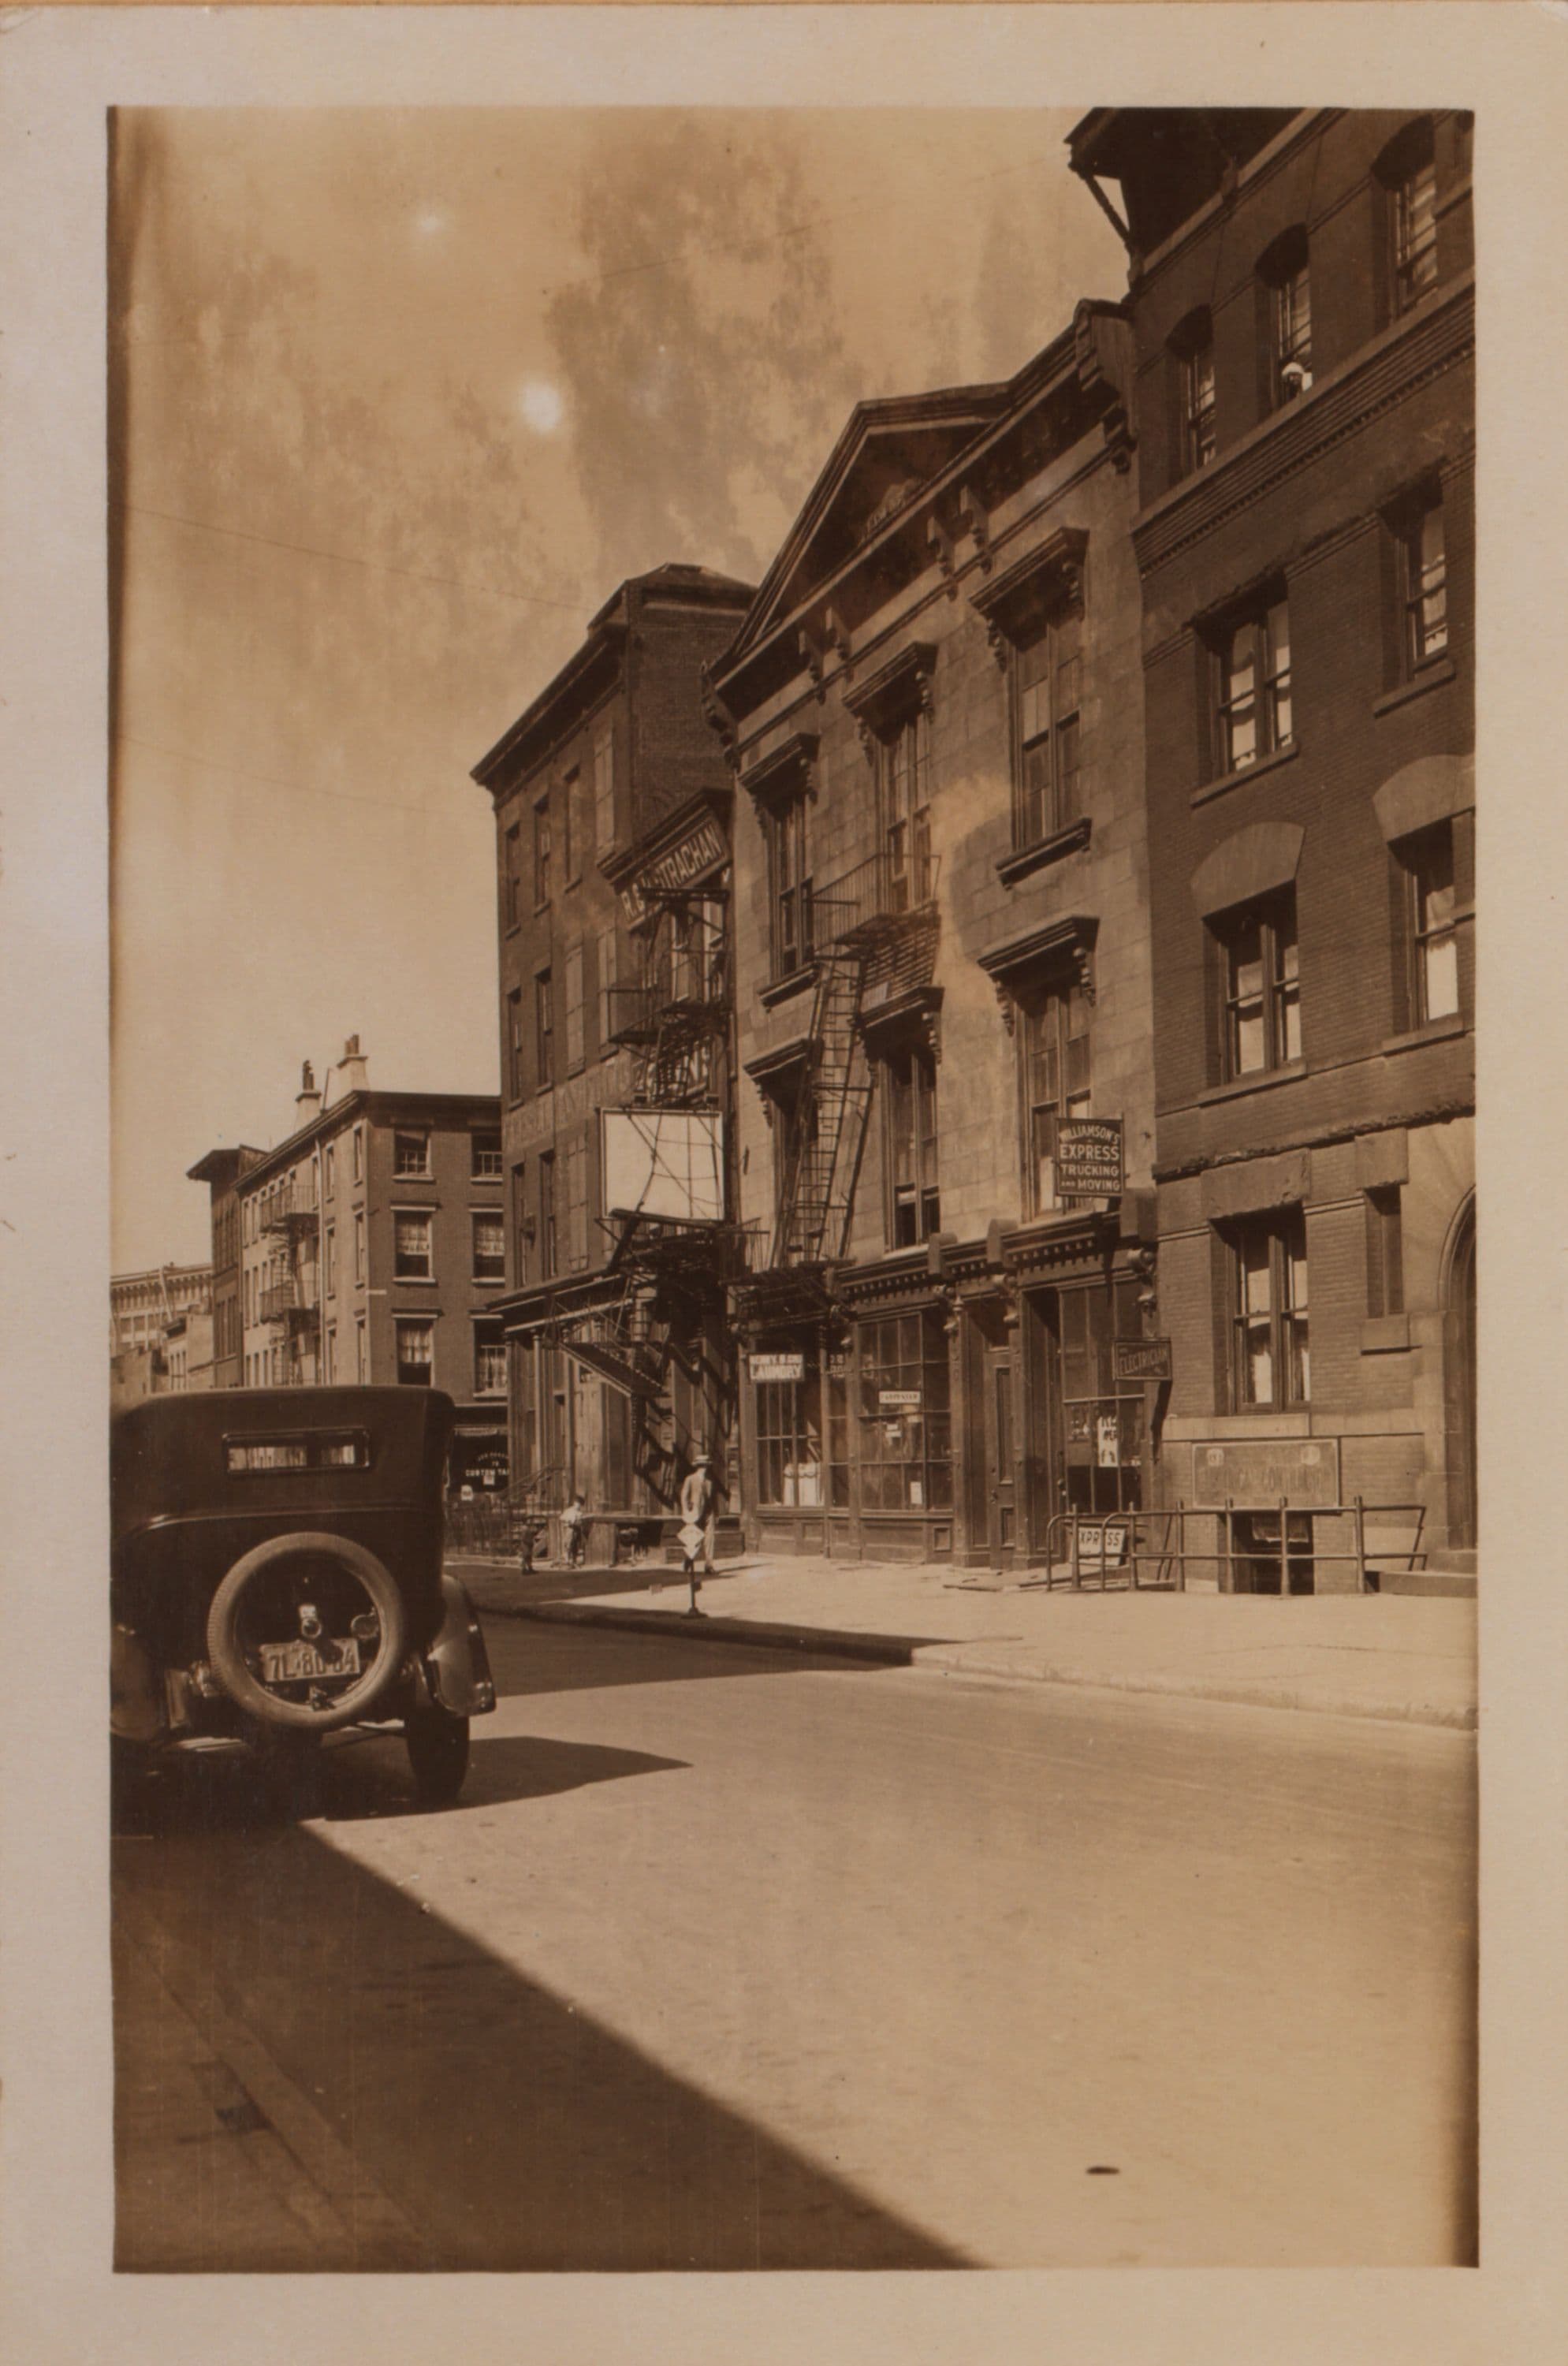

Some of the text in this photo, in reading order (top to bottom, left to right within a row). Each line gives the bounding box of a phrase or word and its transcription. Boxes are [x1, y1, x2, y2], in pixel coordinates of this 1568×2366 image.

[1060, 1144, 1119, 1161] EXPRESS
[1060, 1164, 1119, 1177] TRUCKING
[1078, 1179, 1120, 1191] MOVING
[750, 1365, 802, 1380] LAUNDRY
[1073, 1530, 1120, 1546] XPRSS
